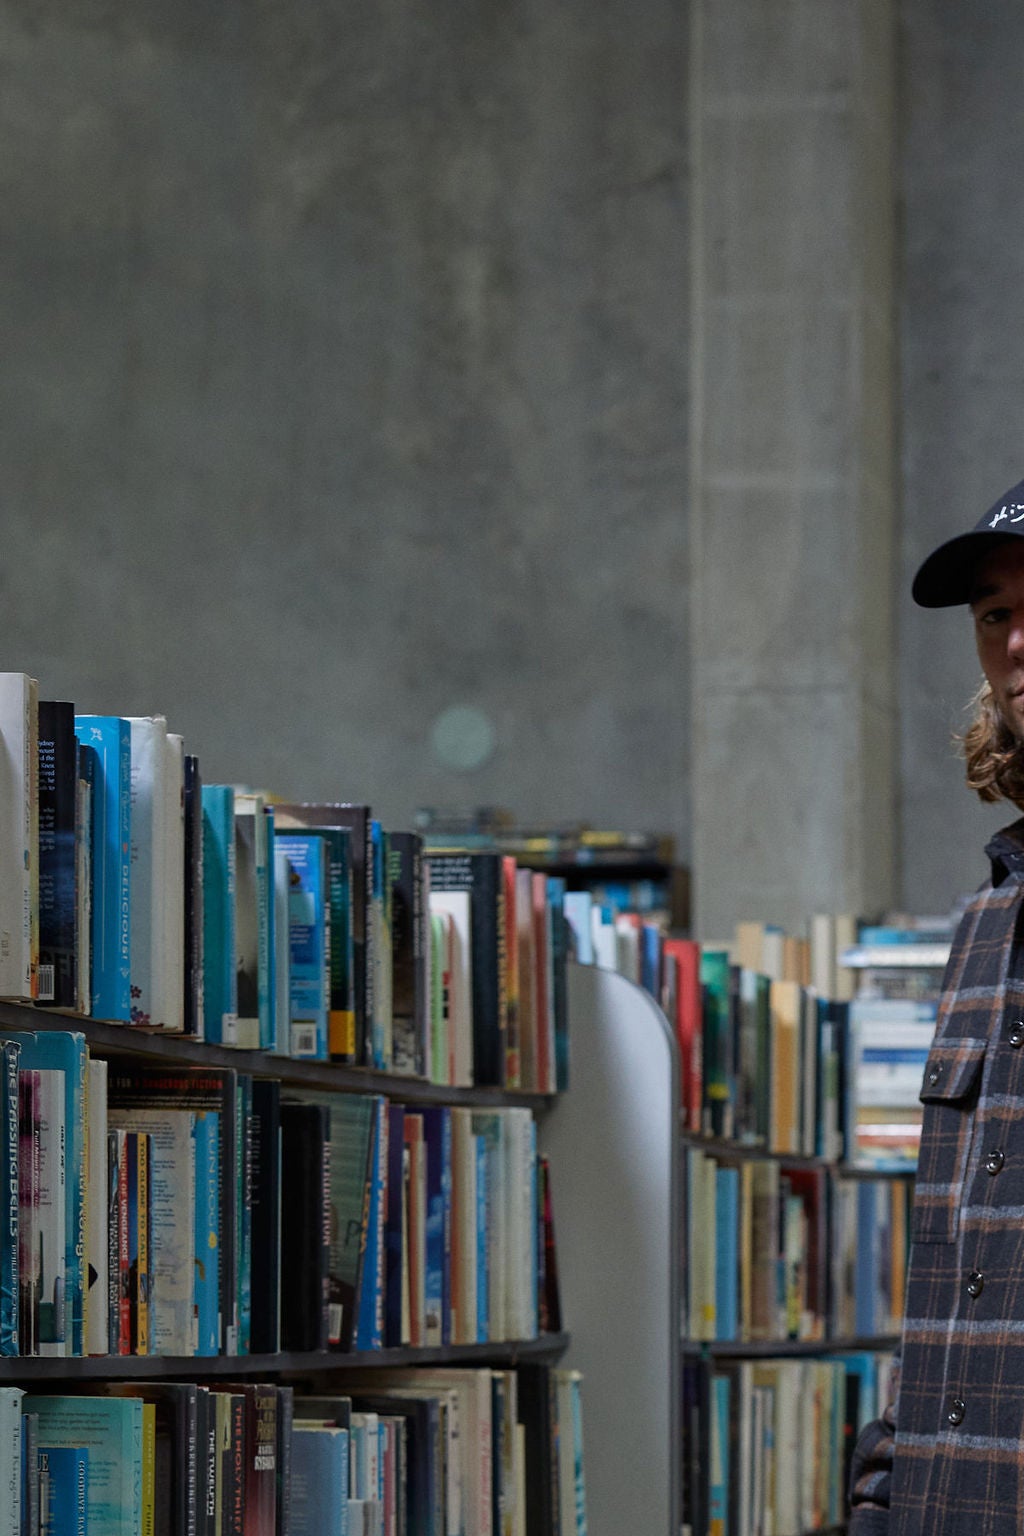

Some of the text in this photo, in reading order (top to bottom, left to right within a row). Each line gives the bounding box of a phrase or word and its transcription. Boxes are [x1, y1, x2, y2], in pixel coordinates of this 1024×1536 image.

[9, 1054, 18, 1089] THE
[9, 1095, 18, 1178] PASSING
[208, 1125, 216, 1227] SUN DOG
[9, 1179, 18, 1236] BELLS
[141, 1215, 146, 1229] TO
[188, 1437, 196, 1503] DARKENING
[207, 1456, 215, 1516] TWELFTH
